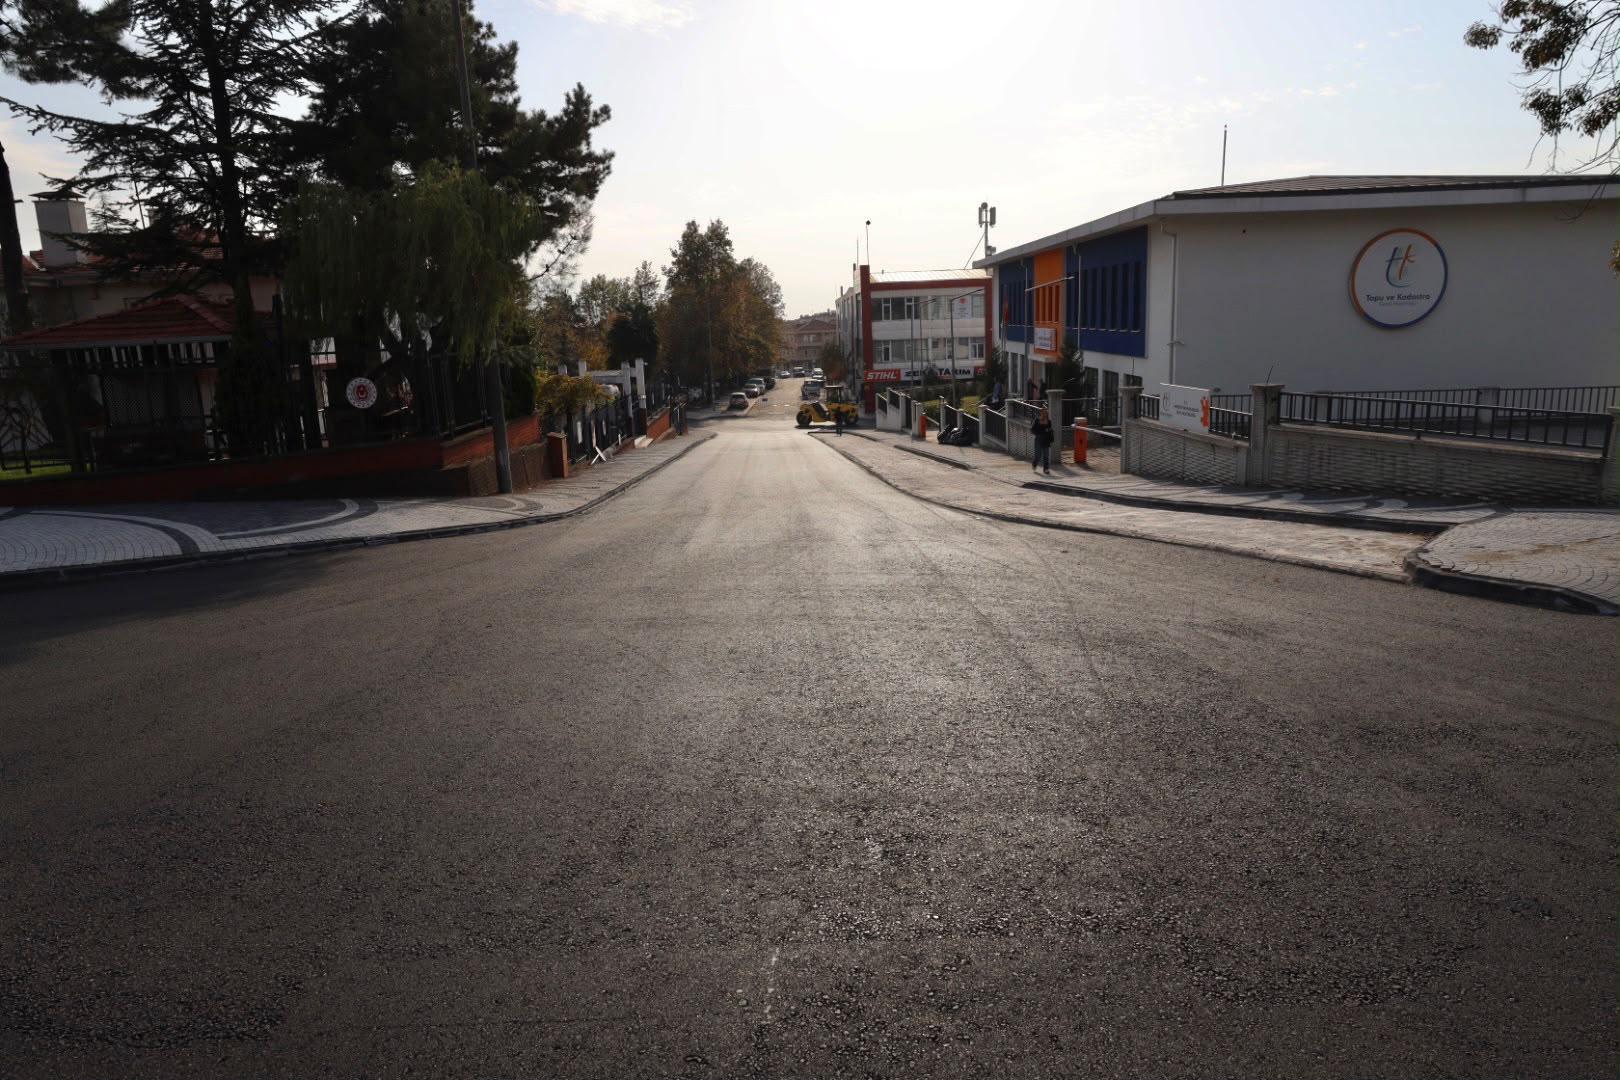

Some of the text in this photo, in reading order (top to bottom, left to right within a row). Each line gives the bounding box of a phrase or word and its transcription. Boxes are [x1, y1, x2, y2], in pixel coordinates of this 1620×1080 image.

[1366, 294, 1384, 302] Tapu
[866, 371, 897, 380] STIHL
[938, 368, 971, 376] TARIM
